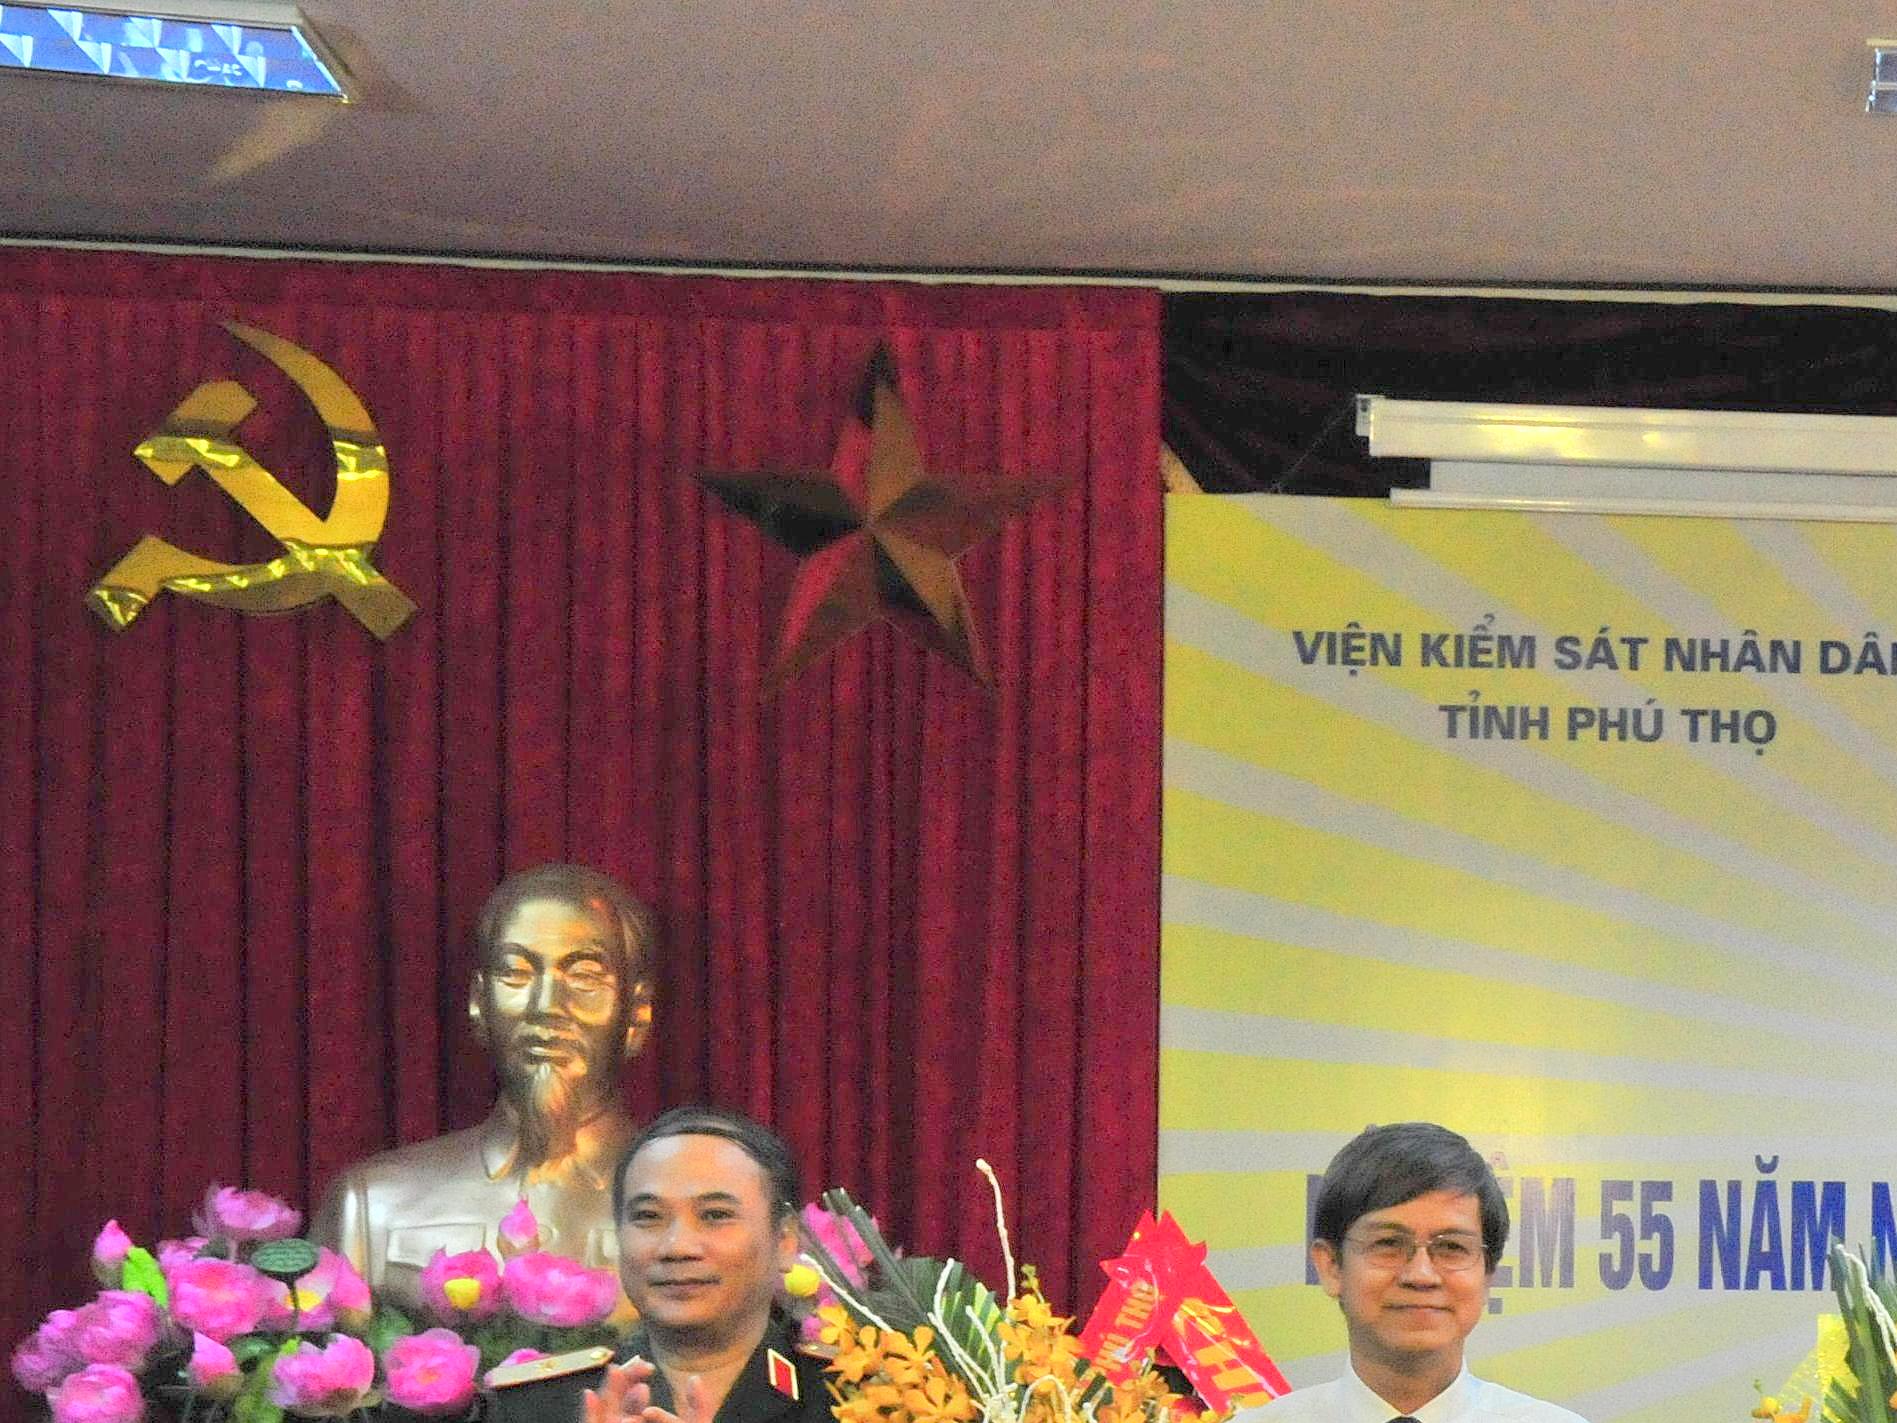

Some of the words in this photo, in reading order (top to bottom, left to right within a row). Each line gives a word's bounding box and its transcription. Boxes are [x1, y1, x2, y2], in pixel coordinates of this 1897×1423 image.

[1292, 623, 1402, 677] VIỆN
[1420, 613, 1537, 670] KIỂM
[1553, 627, 1649, 672] SÁT
[1664, 630, 1802, 676] NHÂN
[1439, 689, 1550, 741] TỈNH
[1566, 698, 1665, 744] PHÚ
[1680, 708, 1777, 757] THỌ
[1599, 1179, 1674, 1291] 55
[1698, 1155, 1846, 1291] NĂM
